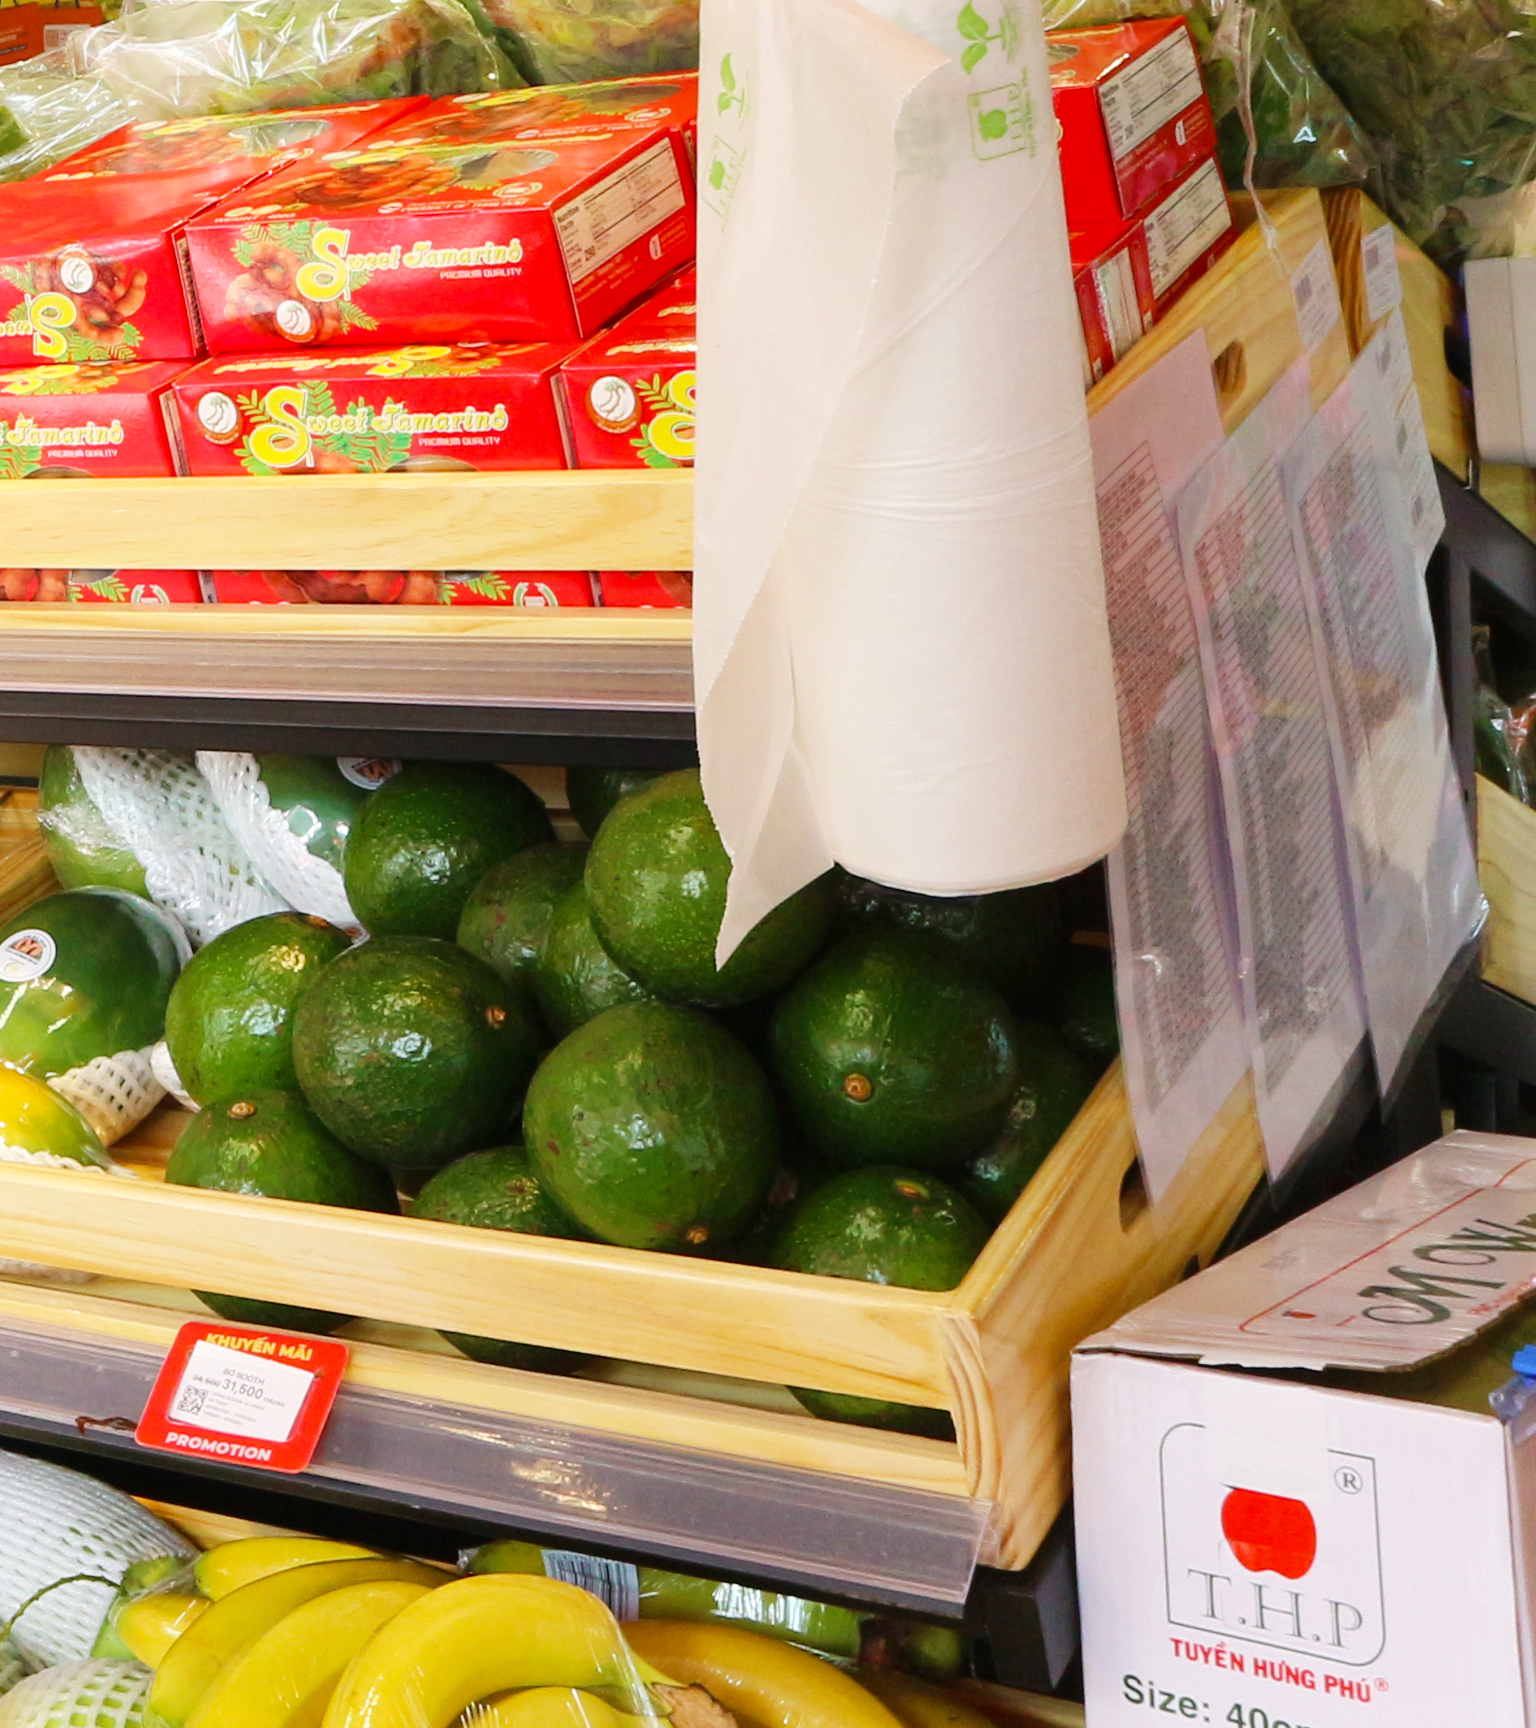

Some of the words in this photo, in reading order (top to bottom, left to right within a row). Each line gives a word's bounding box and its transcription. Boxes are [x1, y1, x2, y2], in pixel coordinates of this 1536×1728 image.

[296, 228, 401, 302] Sweet
[403, 239, 523, 269] Tamarind
[8, 419, 124, 445] Tamarind
[250, 386, 368, 469] Sweet
[371, 404, 508, 434] Tamarind
[206, 1333, 276, 1356] KHUYẾN
[278, 1344, 313, 1361] MÃI
[222, 1379, 264, 1400] 31,500
[165, 1431, 272, 1462] PROMOTION
[1187, 1568, 1363, 1650] T.H.P
[1169, 1637, 1245, 1674] TUYỀN
[1253, 1658, 1317, 1693] HƯNG
[1323, 1674, 1371, 1704] PHÚ
[1122, 1673, 1210, 1722] Size:
